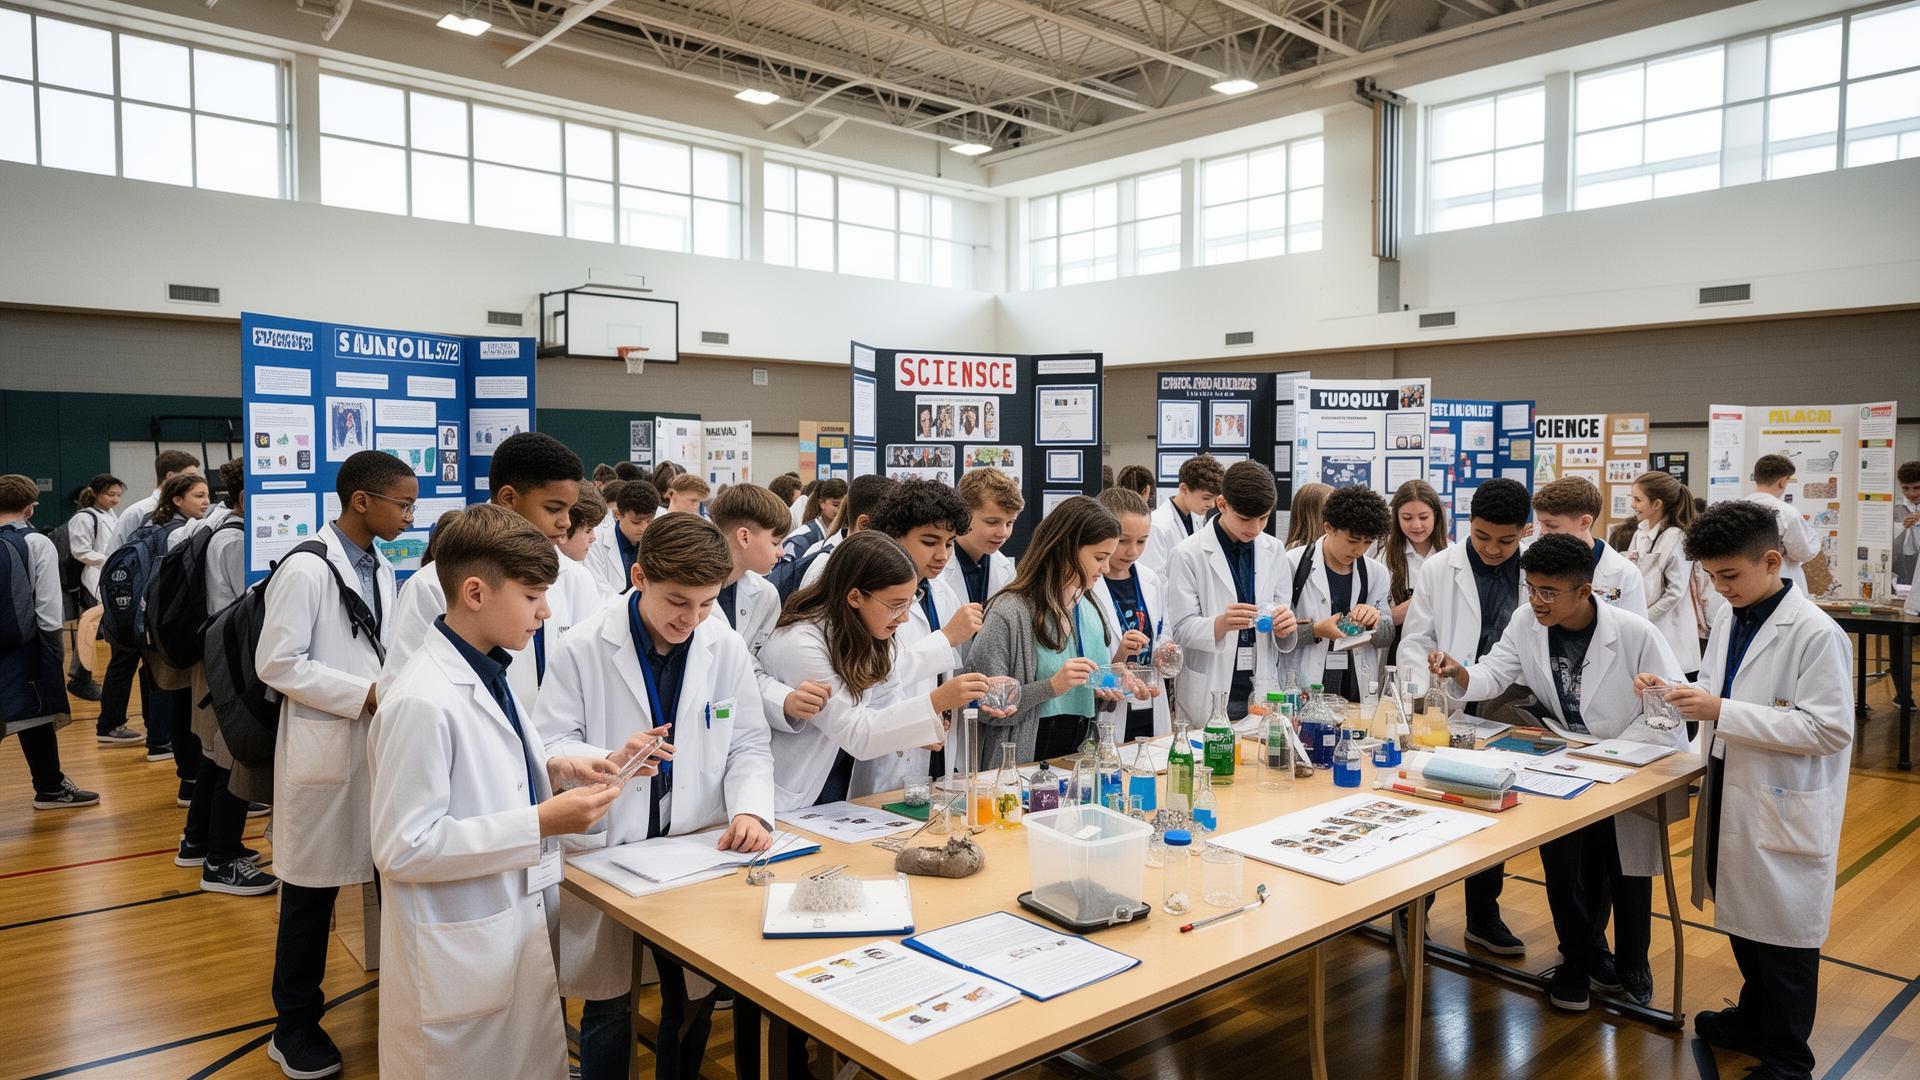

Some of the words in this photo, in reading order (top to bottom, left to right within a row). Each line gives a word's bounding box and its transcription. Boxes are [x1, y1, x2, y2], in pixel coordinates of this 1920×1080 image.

[900, 358, 1013, 388] SCIENSCE
[1319, 391, 1390, 409] TUDQULY
[1536, 418, 1600, 439] CIENCE
